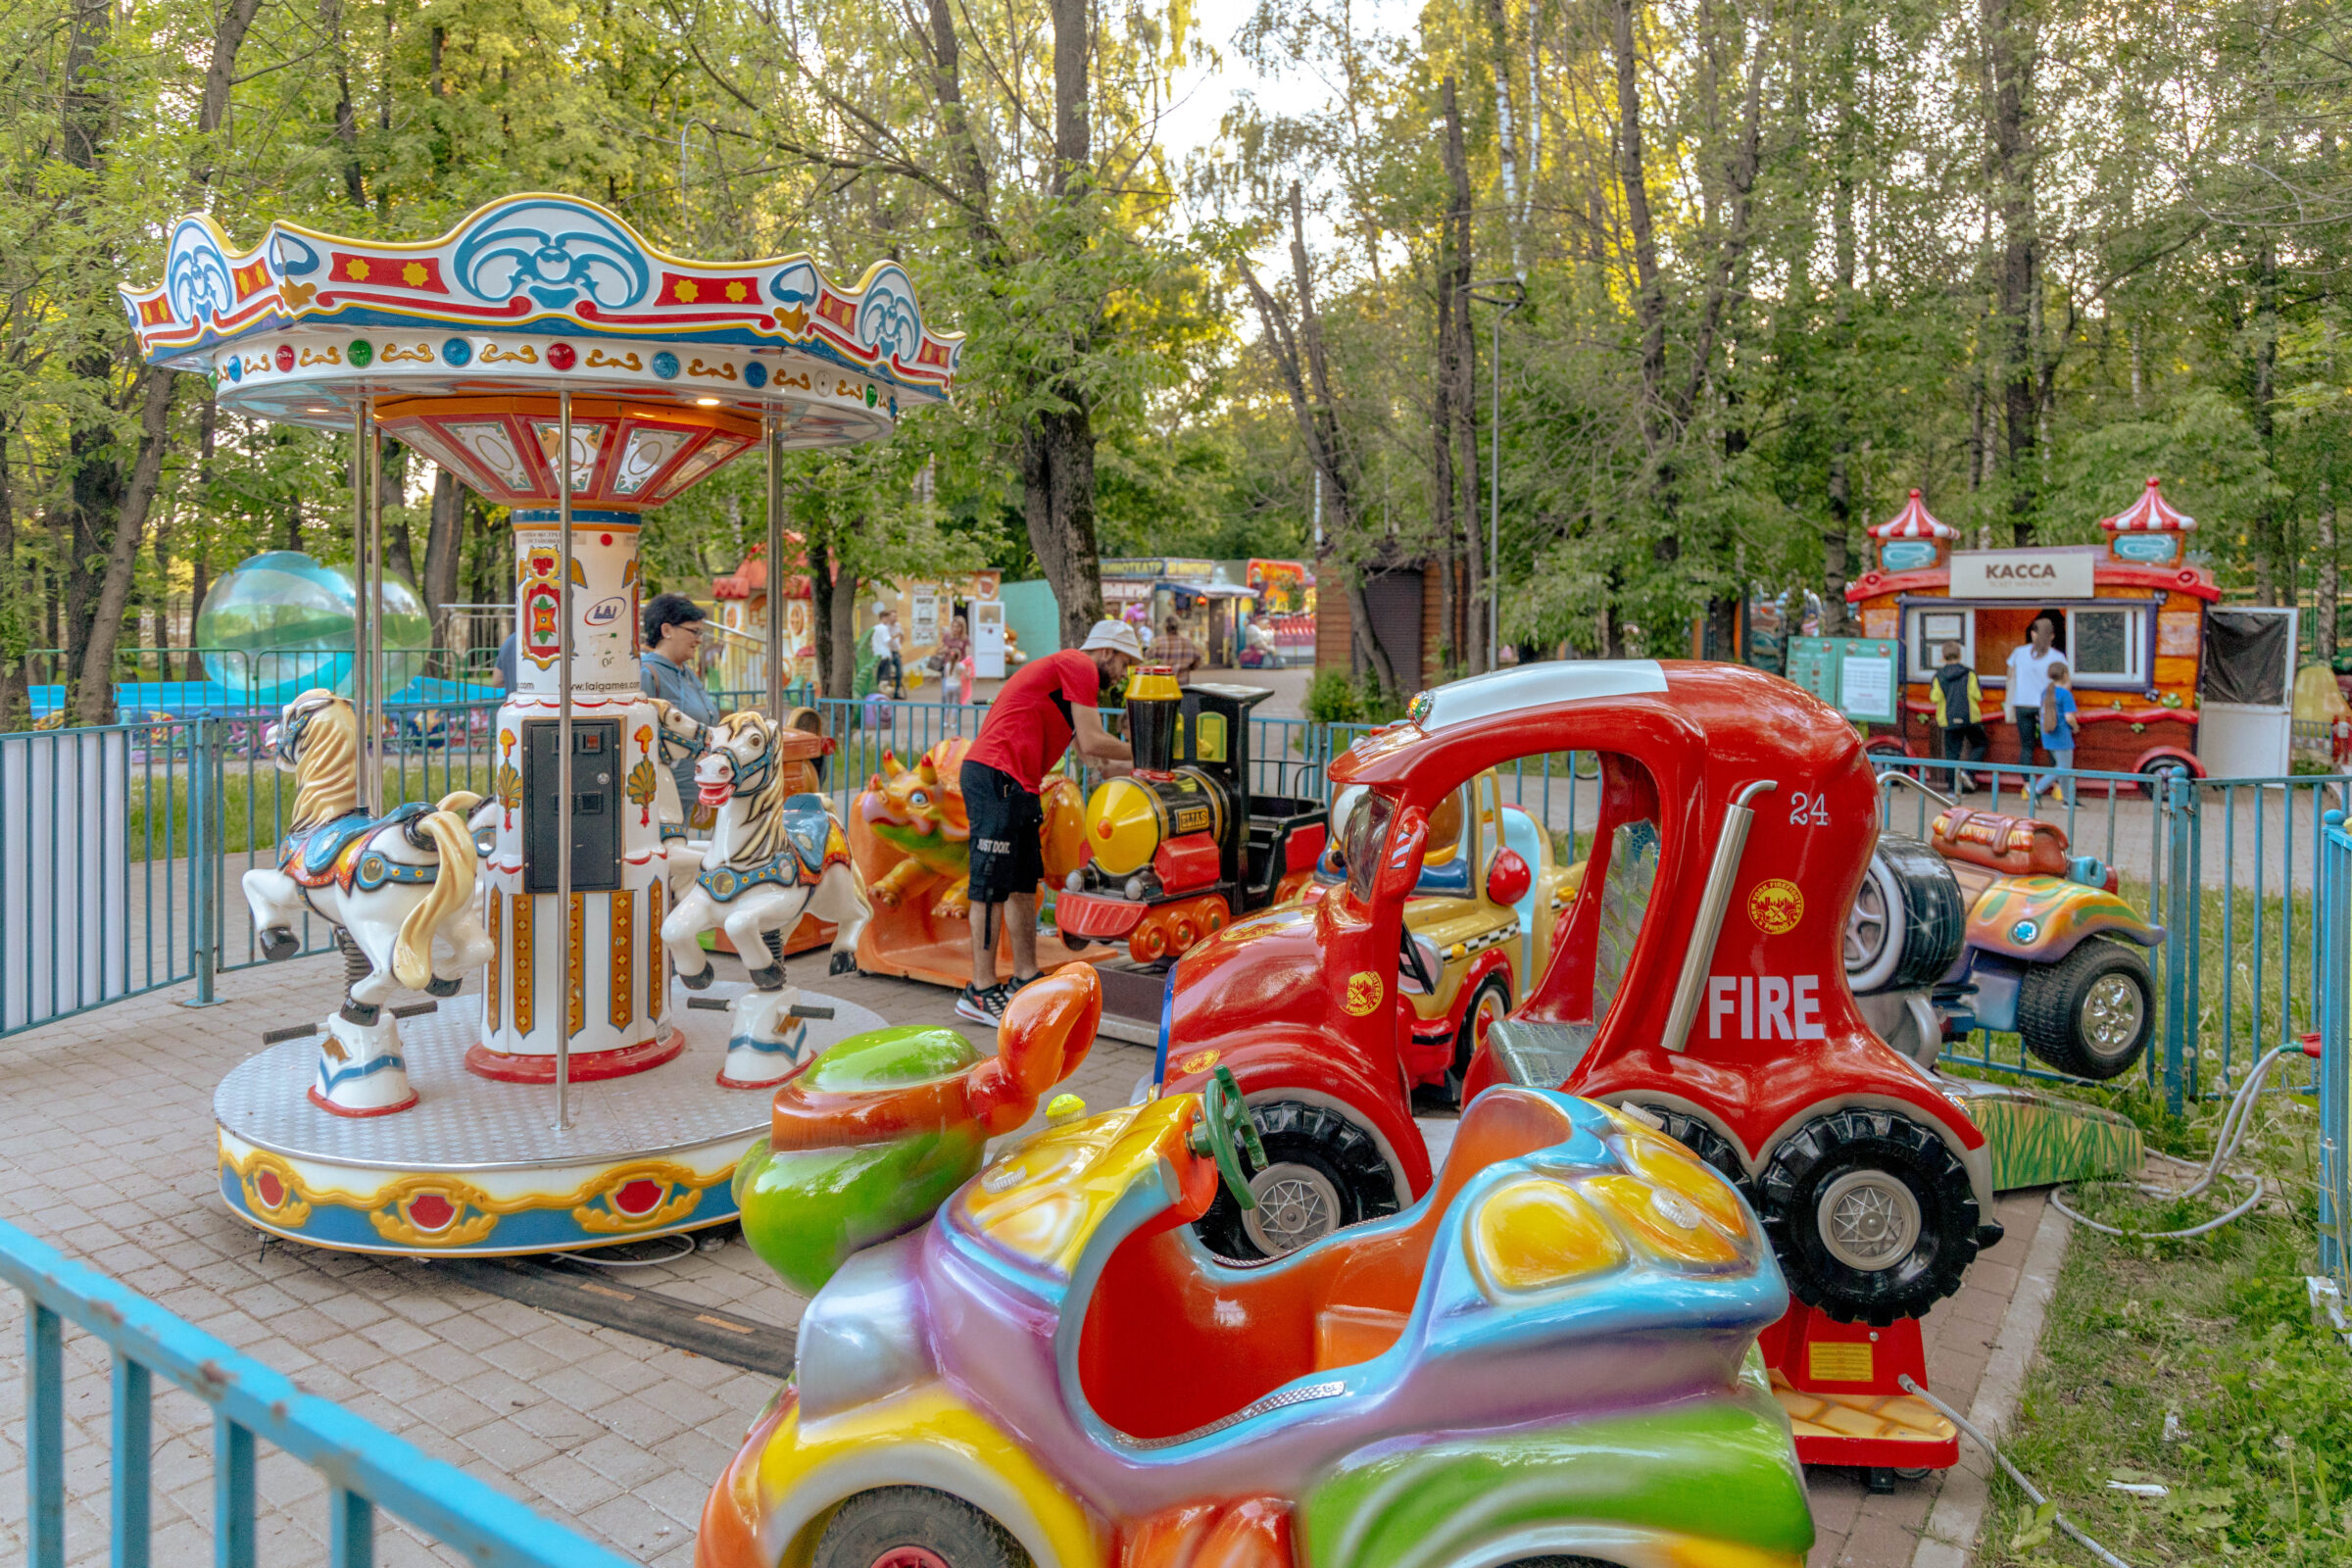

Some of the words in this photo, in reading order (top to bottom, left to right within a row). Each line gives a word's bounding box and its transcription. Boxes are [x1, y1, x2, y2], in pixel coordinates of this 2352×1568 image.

[1985, 564, 2057, 579] КАССА
[1789, 791, 1830, 826] 24
[977, 838, 994, 853] JUST
[1751, 884, 1769, 901] YORK
[1708, 975, 1826, 1040] FIRE
